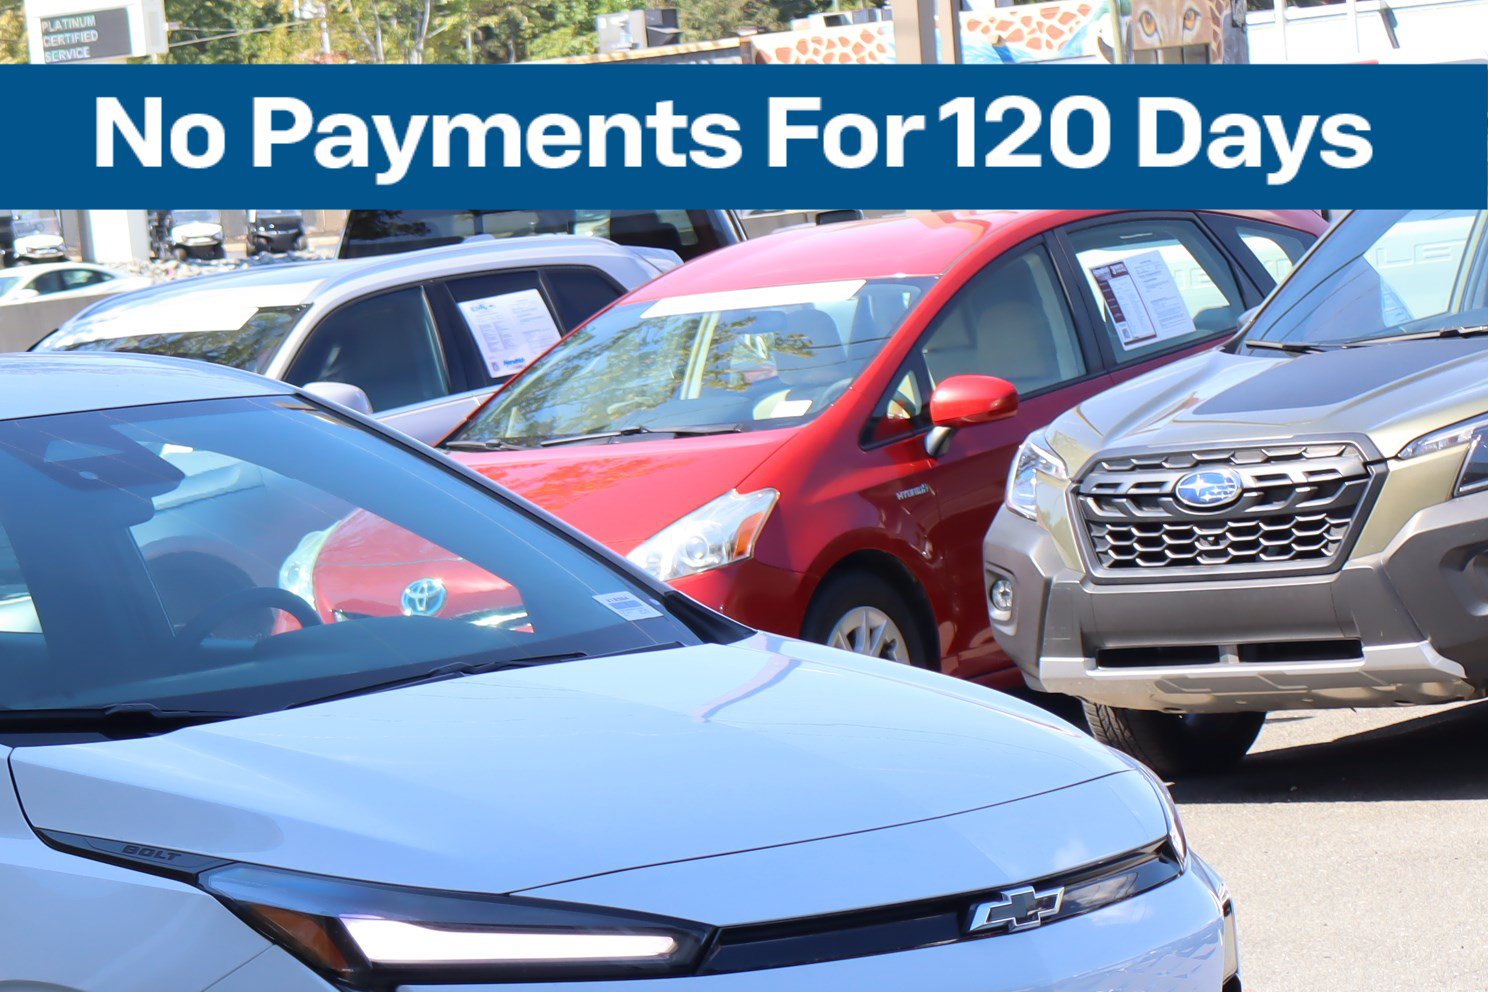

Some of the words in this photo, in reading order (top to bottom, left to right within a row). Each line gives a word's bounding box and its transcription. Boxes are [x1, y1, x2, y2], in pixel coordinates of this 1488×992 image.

[42, 15, 96, 32] PLATINUM
[43, 30, 99, 47] CERTIFIED
[45, 46, 91, 63] SERVICE
[122, 845, 181, 860] BOLT
